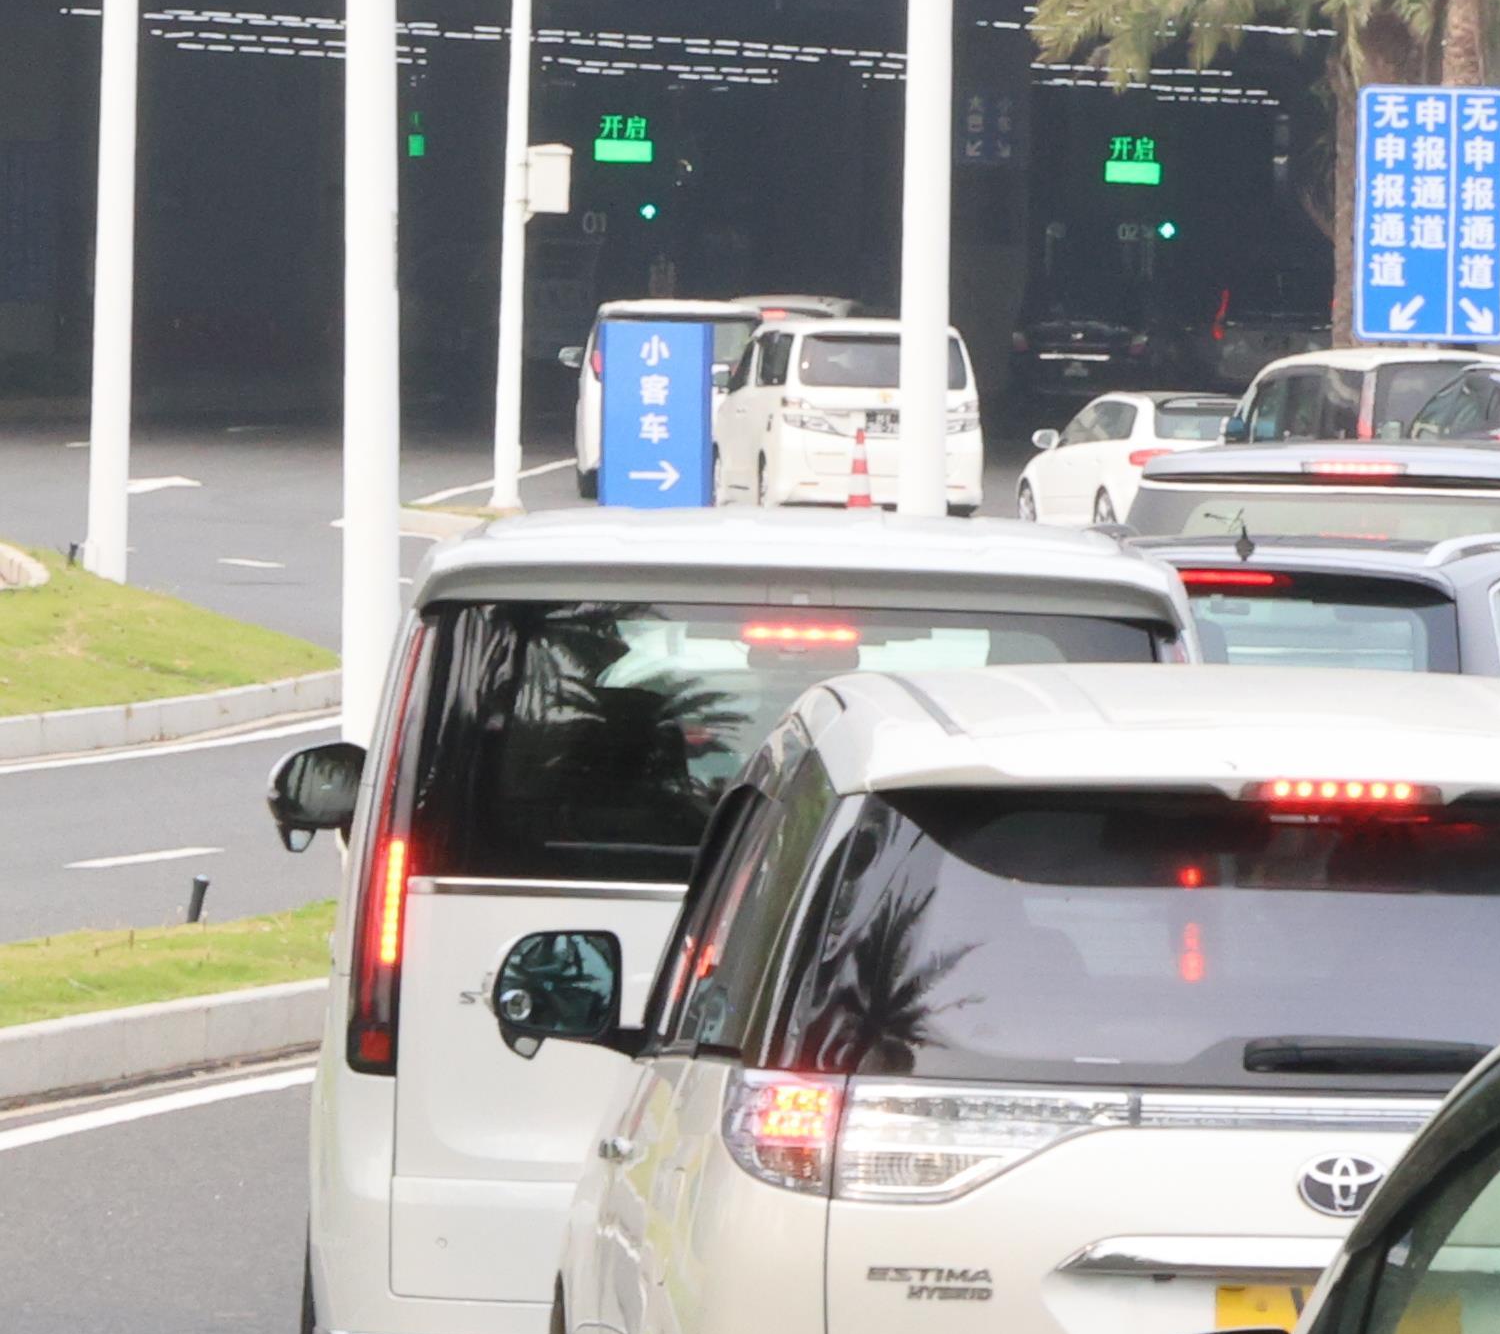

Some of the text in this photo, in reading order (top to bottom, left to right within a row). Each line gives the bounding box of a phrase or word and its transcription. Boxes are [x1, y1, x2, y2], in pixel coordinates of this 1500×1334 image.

[600, 115, 647, 139] 开启
[1109, 136, 1156, 161] 开启
[1369, 94, 1409, 287] 无申报通道
[1410, 97, 1447, 250] 申报通道
[1459, 97, 1498, 290] 无申报通道
[639, 334, 670, 444] 小客车
[867, 1267, 992, 1283] ESTIMA
[907, 1285, 992, 1300] HYBRID
